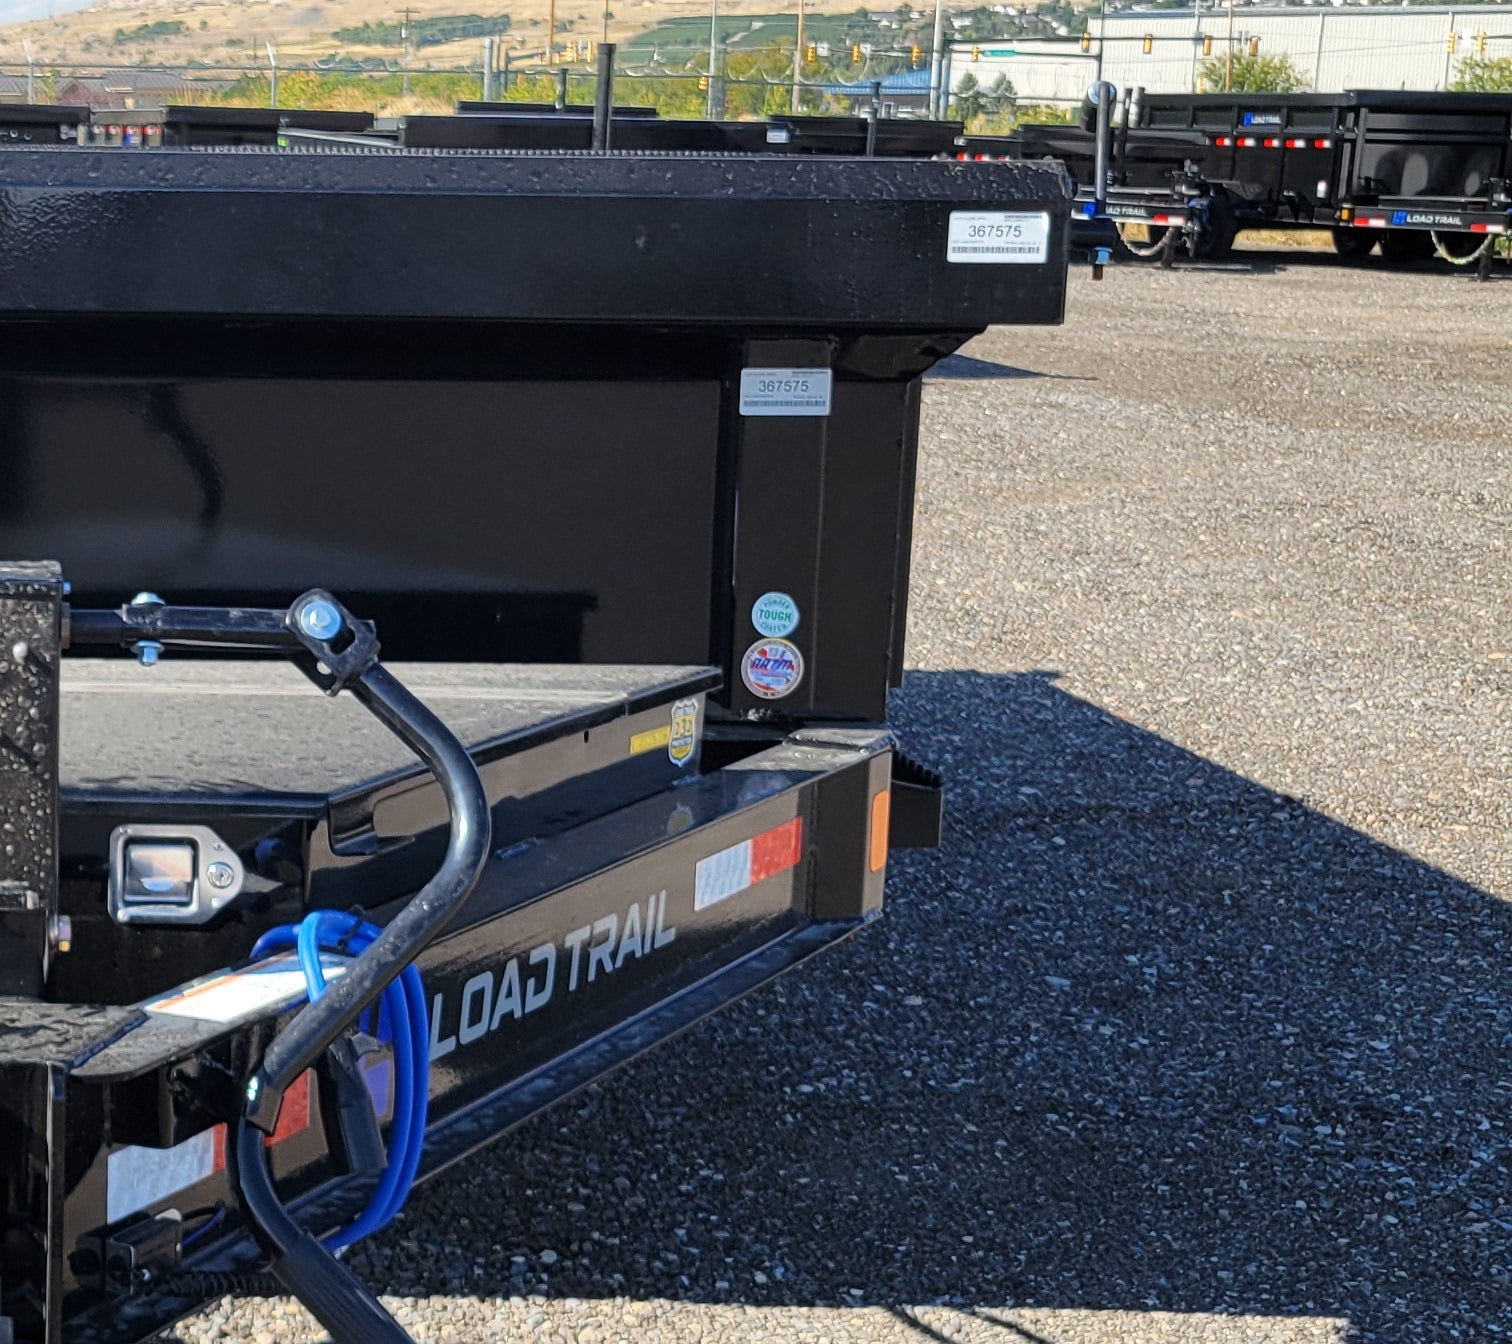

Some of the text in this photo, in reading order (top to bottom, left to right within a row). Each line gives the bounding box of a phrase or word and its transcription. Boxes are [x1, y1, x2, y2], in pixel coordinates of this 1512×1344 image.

[1406, 214, 1463, 226] LOAD TRAIL
[968, 225, 1022, 238] 367575
[758, 380, 809, 393] 367575
[758, 608, 792, 622] TOUGH
[430, 889, 677, 1062] LOAD TRAIL
